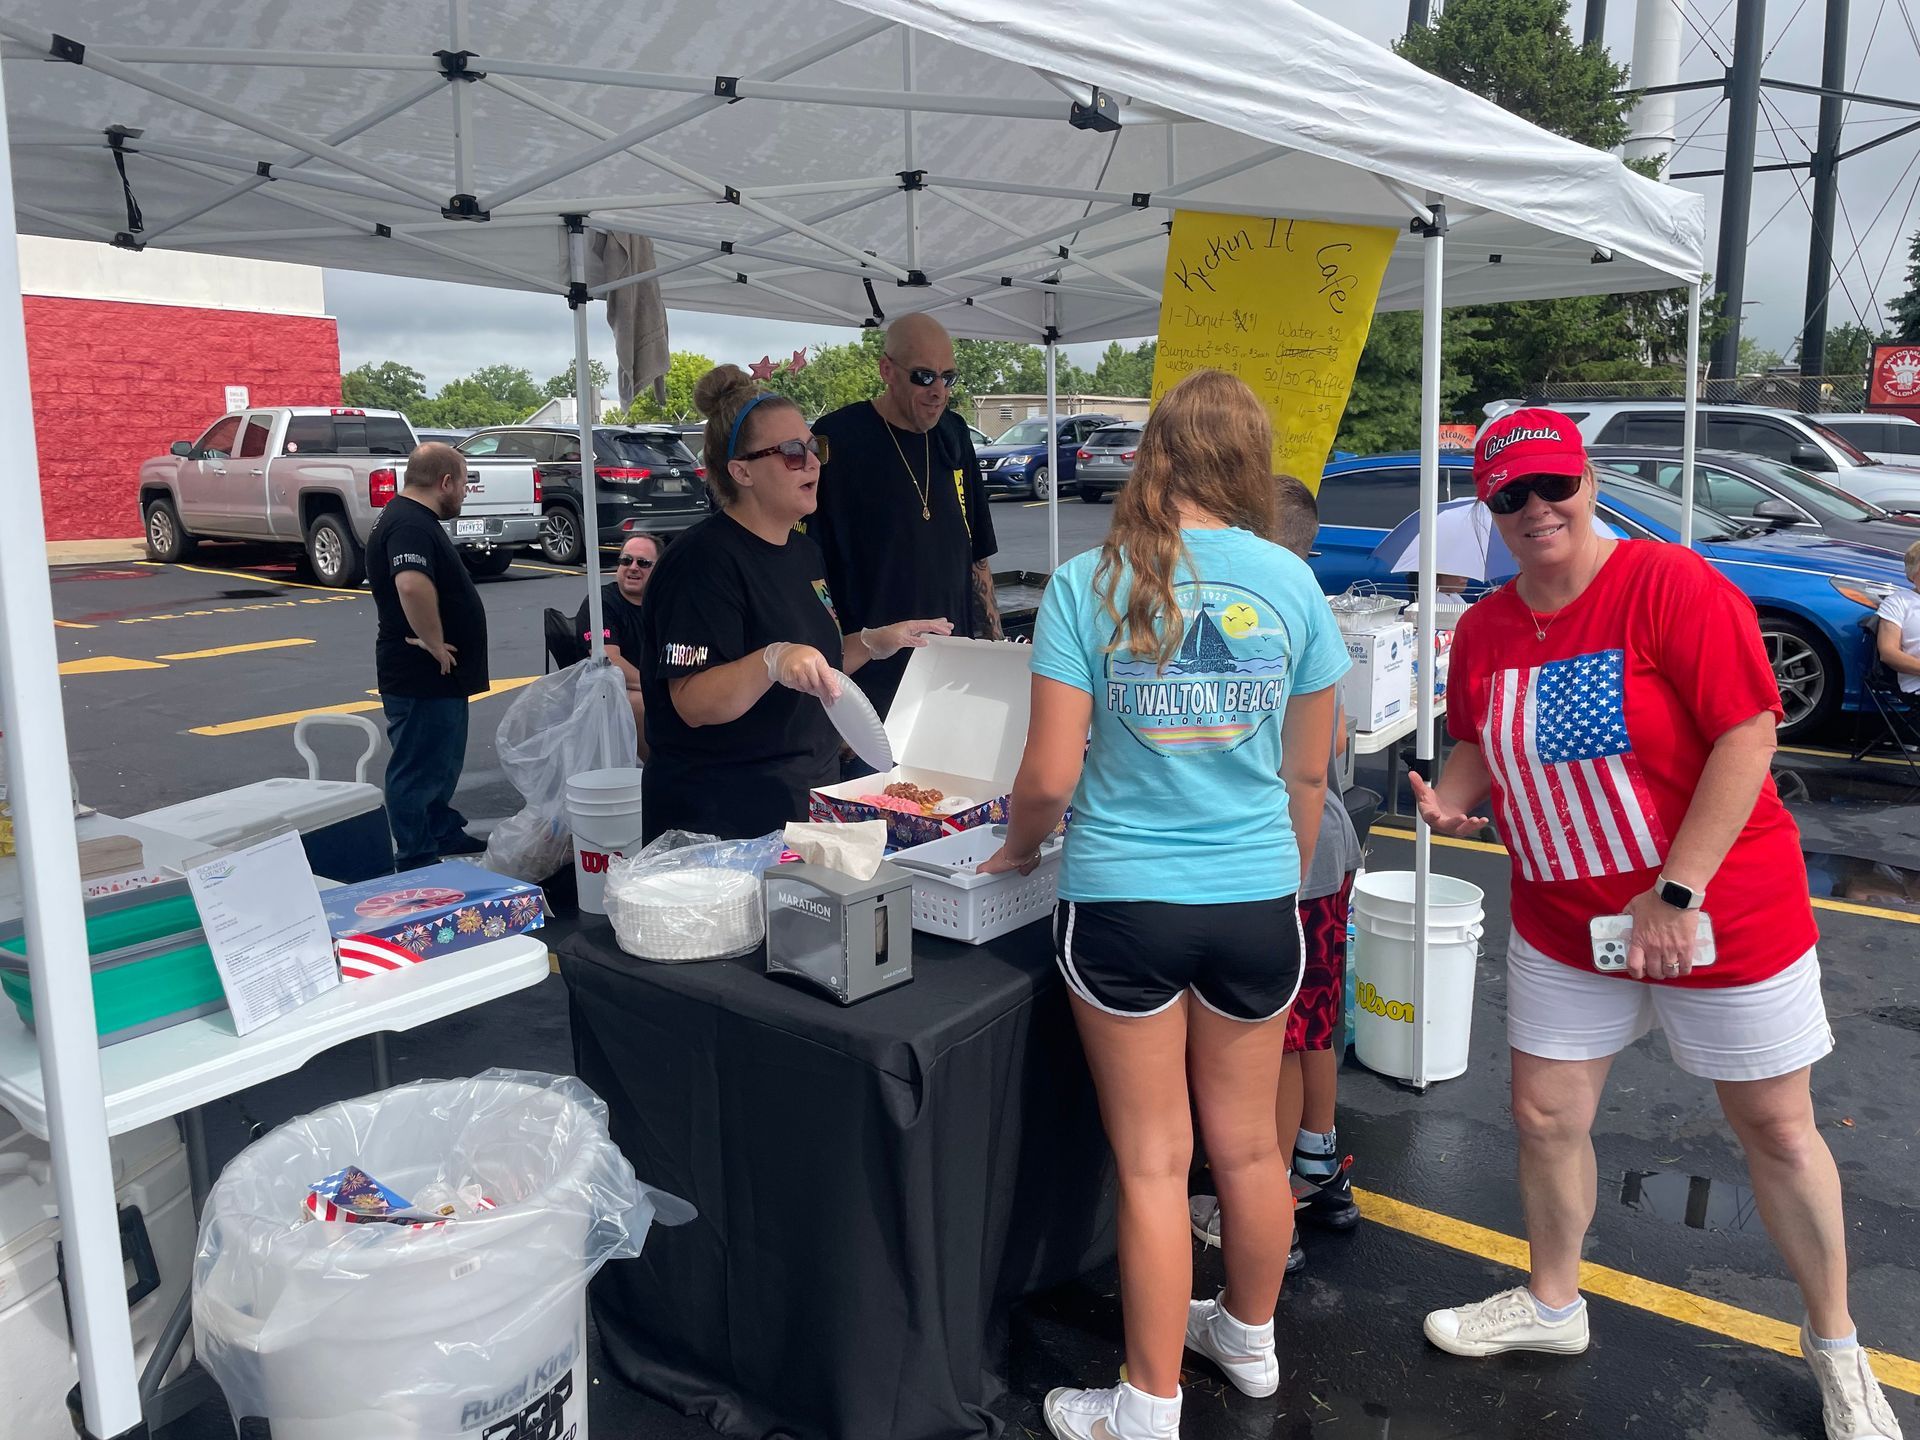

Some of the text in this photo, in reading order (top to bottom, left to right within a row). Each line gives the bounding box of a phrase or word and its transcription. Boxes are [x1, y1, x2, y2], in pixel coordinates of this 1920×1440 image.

[1263, 217, 1295, 253] It
[1316, 243, 1359, 314] Cafe
[1278, 321, 1317, 340] Water
[1440, 430, 1470, 444] elcome
[1484, 426, 1563, 461] Cardinals
[465, 485, 485, 493] MC
[392, 554, 404, 567] GET
[1202, 591, 1228, 602] 1925
[665, 642, 709, 667] THROWN
[1107, 678, 1286, 717] FT. WALTON BEACH
[1157, 715, 1238, 726] FLORIDA
[778, 891, 831, 918] MARATHON
[882, 966, 907, 980] MARATHON
[1355, 976, 1415, 1024] ilson
[461, 1374, 529, 1426] Rural
